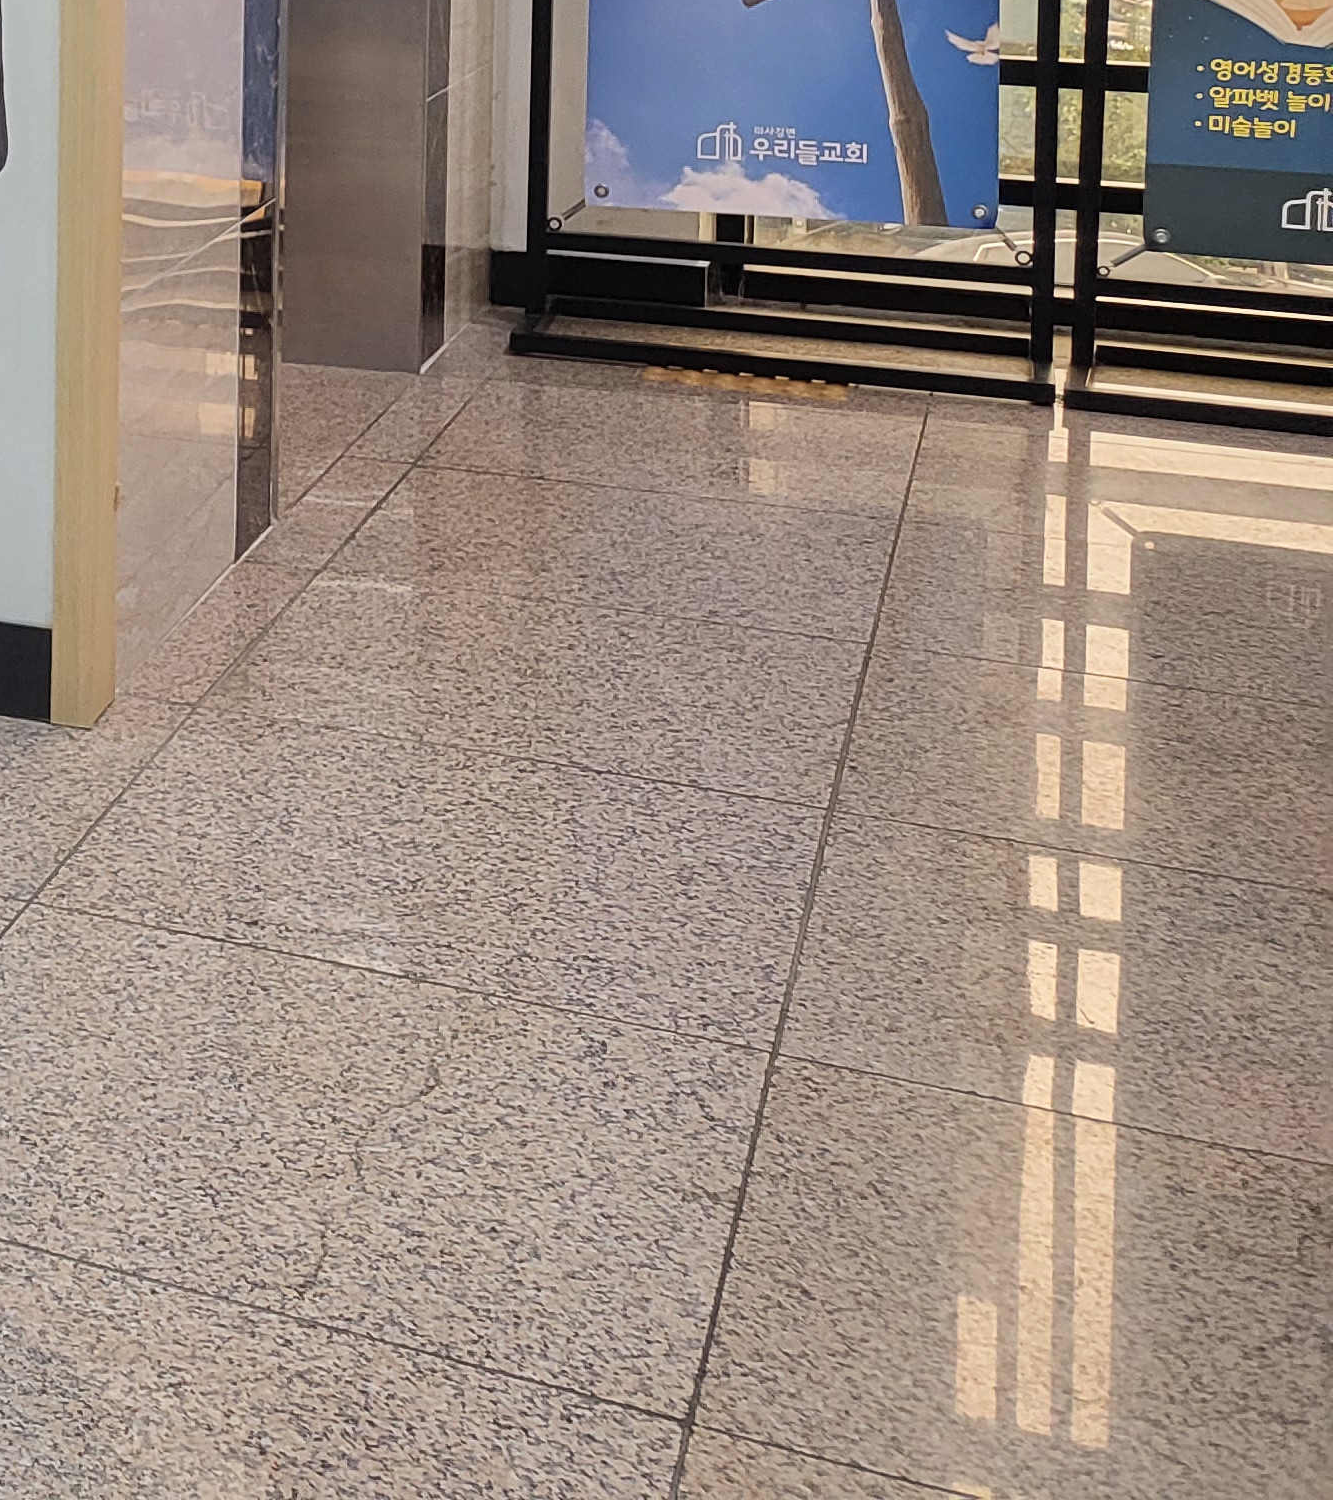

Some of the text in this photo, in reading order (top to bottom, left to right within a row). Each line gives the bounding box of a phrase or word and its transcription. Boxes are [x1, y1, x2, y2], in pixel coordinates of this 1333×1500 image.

[1208, 85, 1332, 113] 알파벳 놀이
[1207, 114, 1297, 139] 미술놀이
[748, 137, 868, 166] 우리들교회
